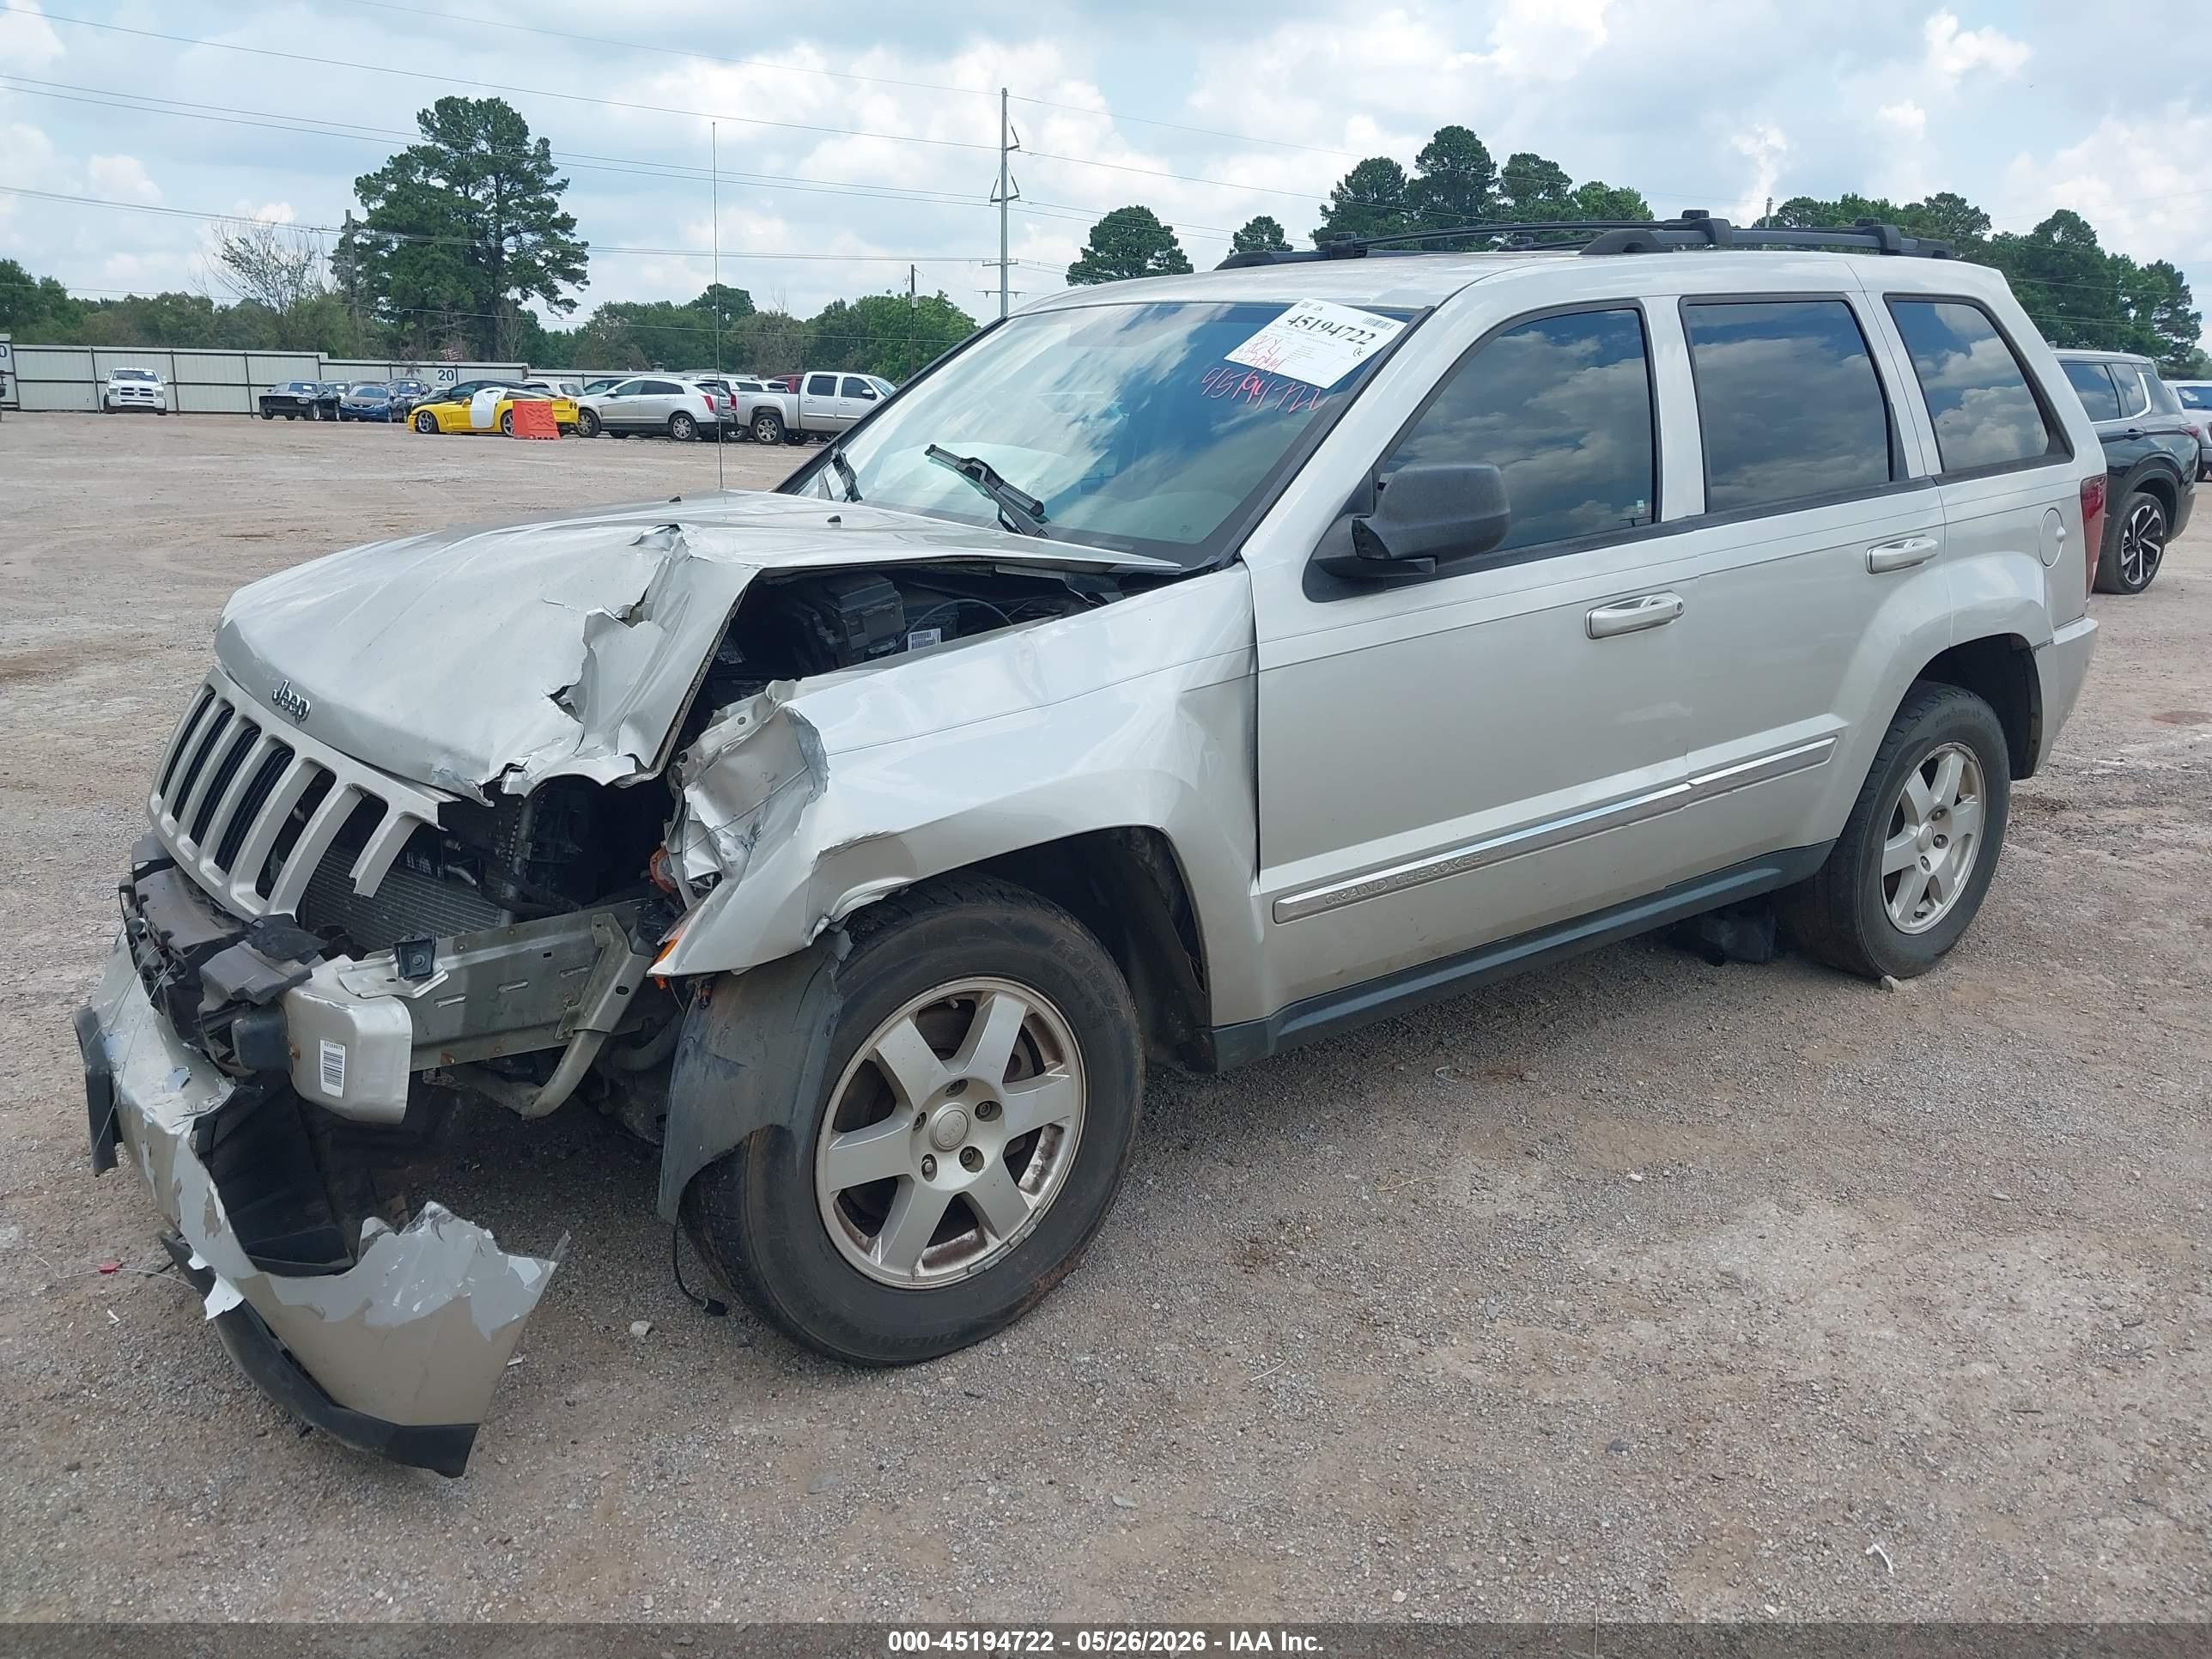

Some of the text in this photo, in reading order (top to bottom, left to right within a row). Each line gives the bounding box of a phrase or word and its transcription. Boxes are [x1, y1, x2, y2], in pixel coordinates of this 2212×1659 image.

[1287, 314, 1376, 344] 45194722
[438, 369, 454, 381] 20
[272, 679, 311, 726] Jeep
[1325, 853, 1485, 906] GRAND CHEROKEE
